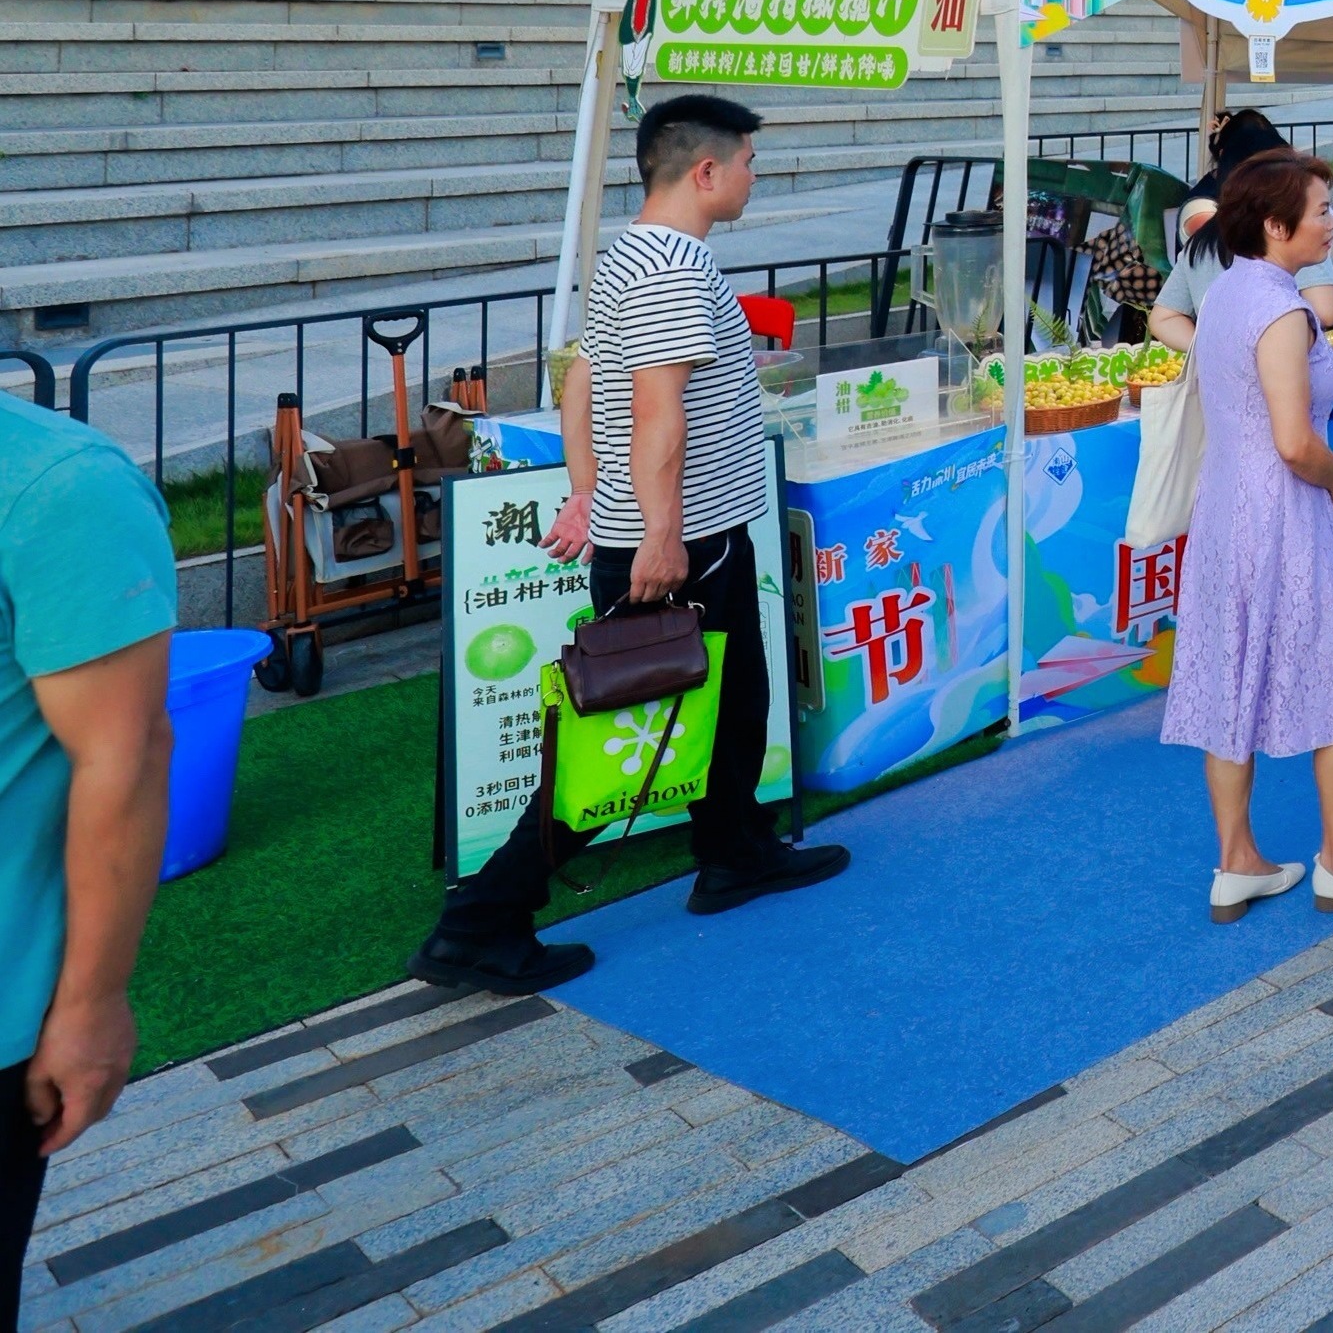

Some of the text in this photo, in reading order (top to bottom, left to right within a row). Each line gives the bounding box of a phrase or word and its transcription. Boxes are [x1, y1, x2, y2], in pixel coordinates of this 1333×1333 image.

[825, 589, 935, 705] 节
[473, 684, 497, 697] 今天
[476, 774, 537, 798] 3秒回甘
[466, 793, 534, 818] 0添加/0
